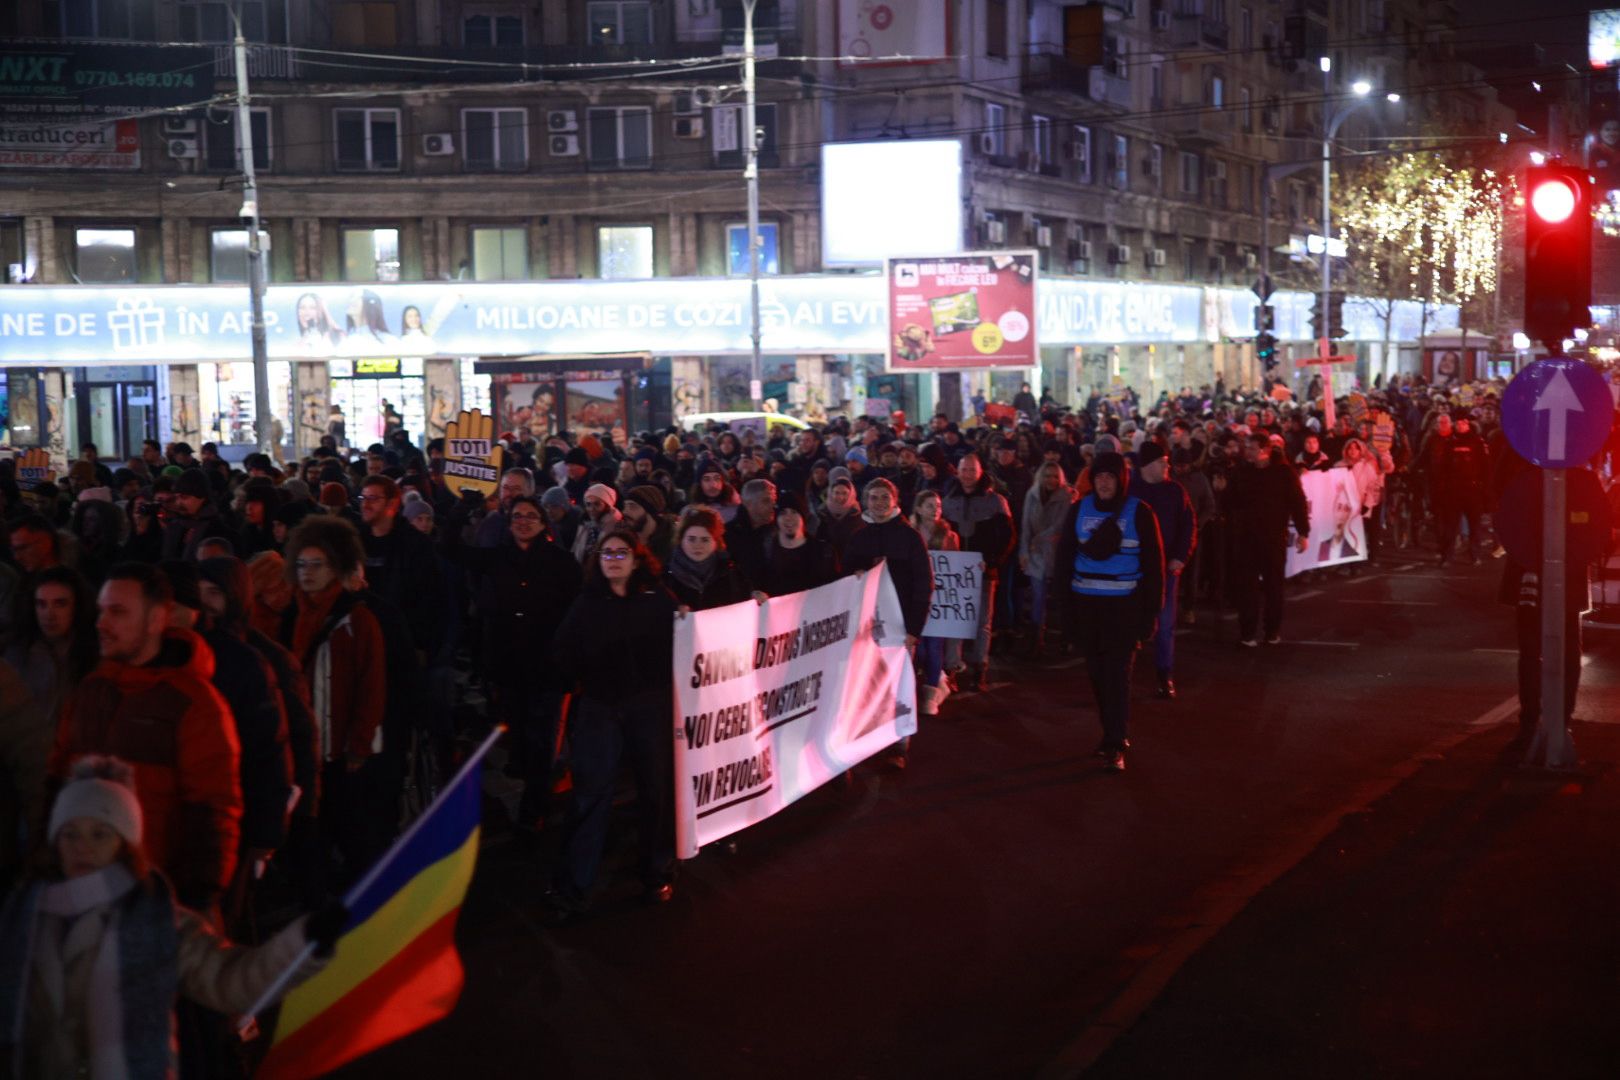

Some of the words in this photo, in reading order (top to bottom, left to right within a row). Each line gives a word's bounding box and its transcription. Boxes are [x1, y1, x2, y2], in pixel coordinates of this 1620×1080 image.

[0, 56, 68, 82] NXT
[55, 312, 97, 337] DE
[475, 303, 621, 330] MILIOANE
[626, 303, 667, 328] DE
[673, 302, 743, 327] COZI
[793, 301, 824, 325] AI
